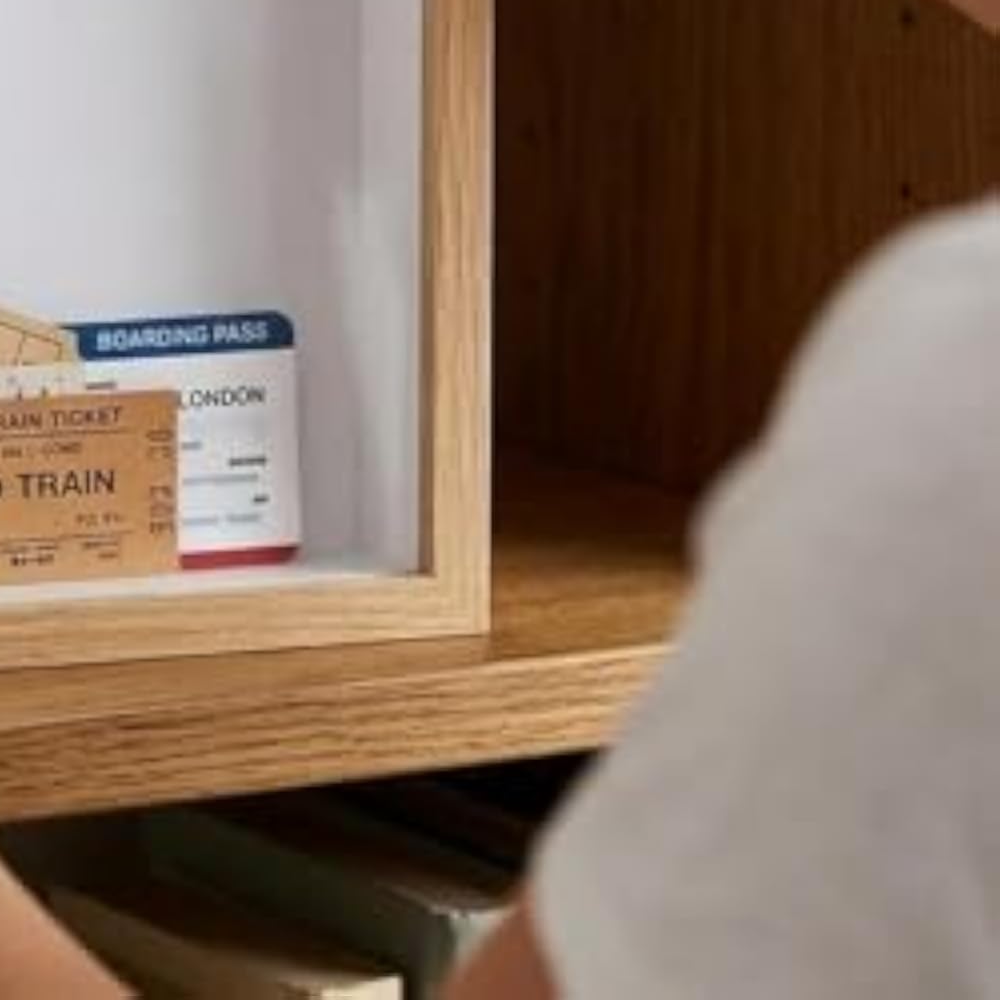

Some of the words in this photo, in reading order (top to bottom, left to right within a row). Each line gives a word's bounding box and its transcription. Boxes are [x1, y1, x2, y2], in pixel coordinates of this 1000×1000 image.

[96, 325, 208, 353] BOARDING
[213, 320, 268, 344] PASS
[52, 406, 123, 428] TICKET
[15, 469, 115, 498] TRAIN
